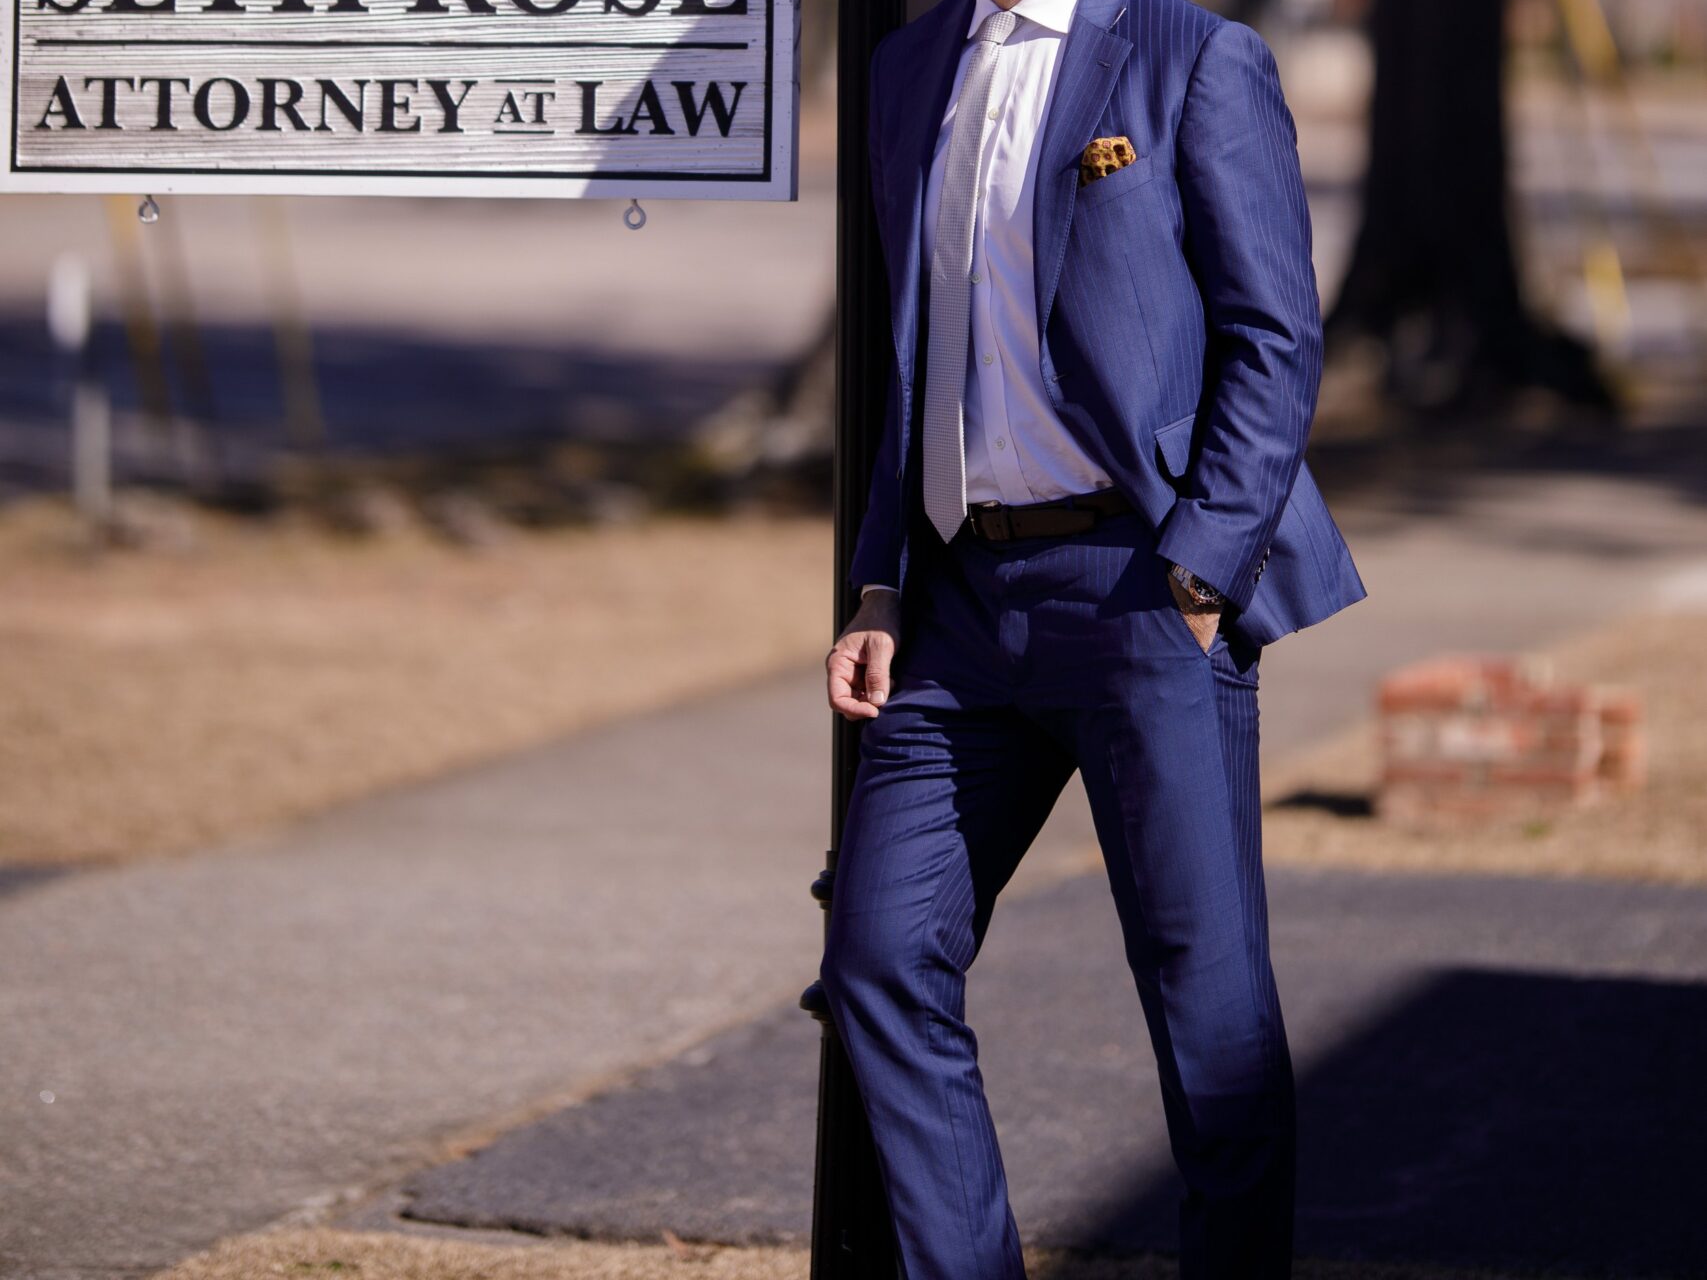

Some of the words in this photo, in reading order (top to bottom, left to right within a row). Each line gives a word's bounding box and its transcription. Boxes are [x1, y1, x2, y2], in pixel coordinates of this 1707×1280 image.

[36, 75, 478, 134] ATTORNEY
[496, 91, 556, 125] AT
[574, 80, 750, 137] LAW
